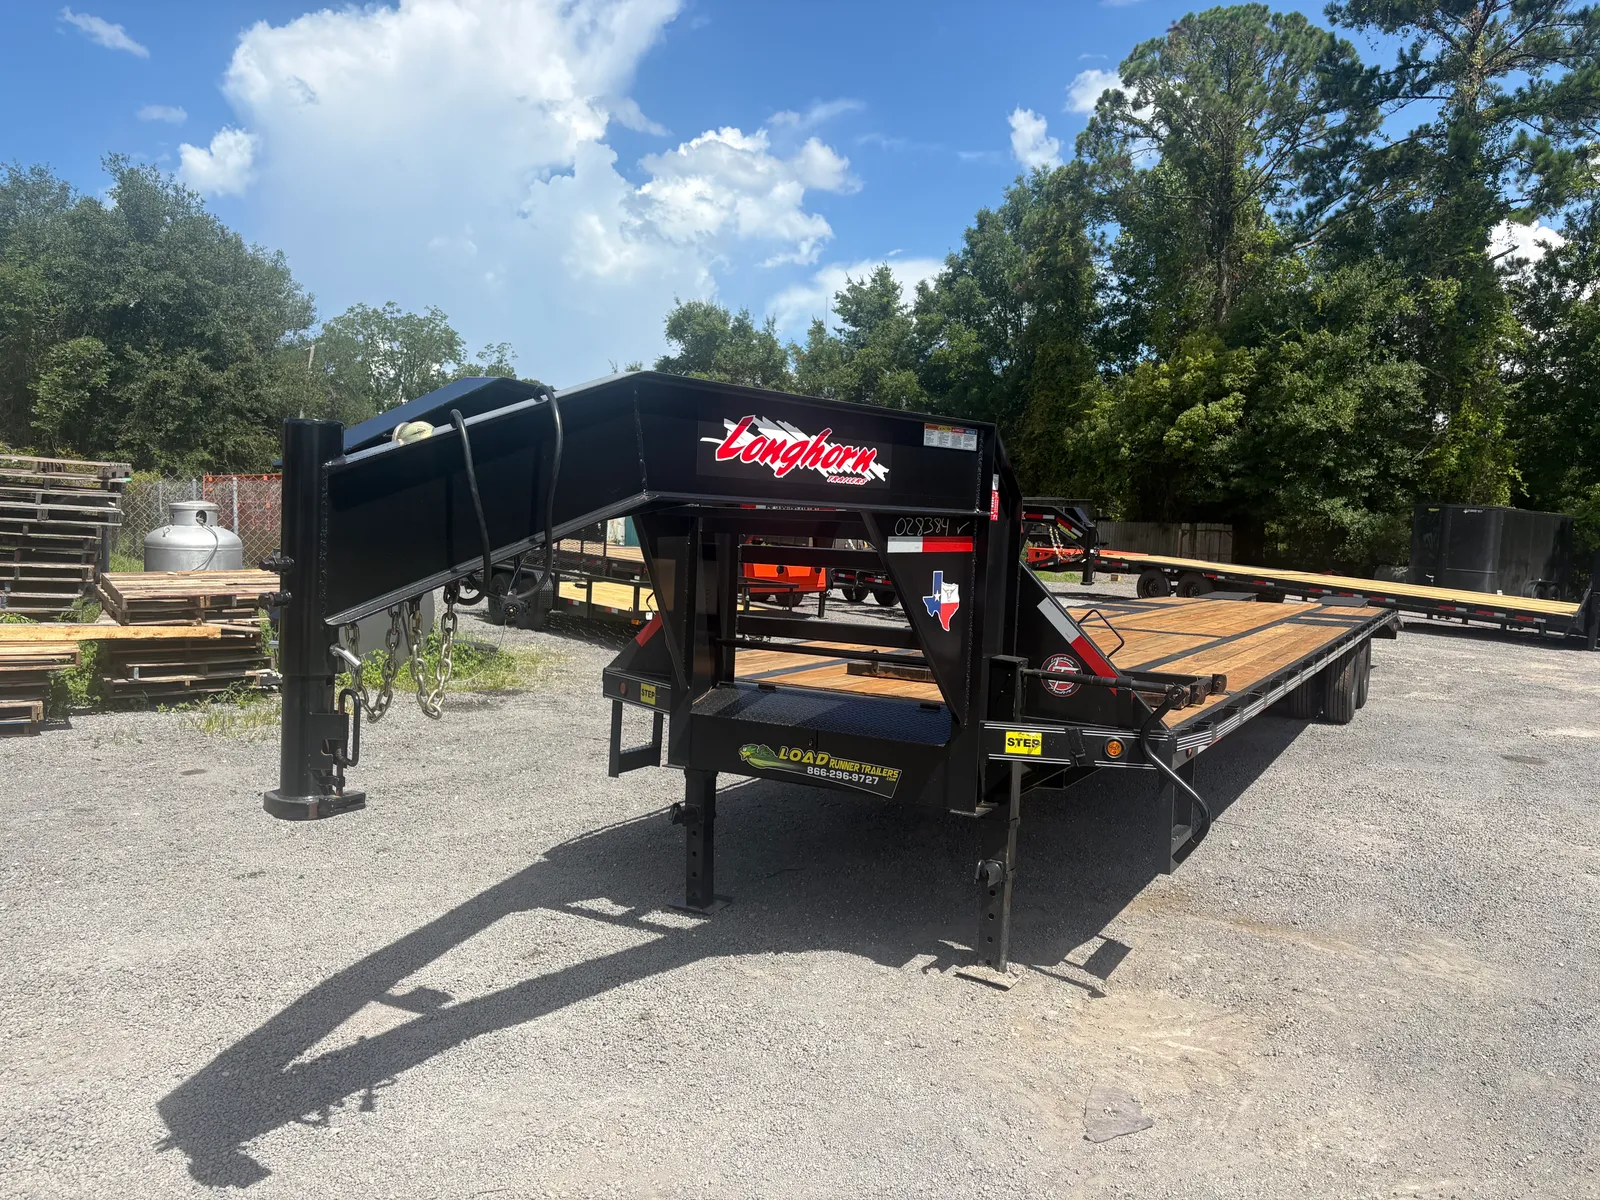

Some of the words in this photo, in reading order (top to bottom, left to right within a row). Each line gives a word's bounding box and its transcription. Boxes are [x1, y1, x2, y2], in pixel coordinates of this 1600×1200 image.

[716, 415, 878, 478] Longhorn
[827, 475, 868, 485] TRAILERS
[894, 517, 950, 536] 028384
[641, 688, 656, 699] STEP
[1007, 737, 1041, 748] STEP
[778, 747, 829, 766] LOAD
[829, 758, 860, 772] RUNNER
[861, 764, 899, 778] TRAILERS
[807, 766, 879, 785] 866-296-9727
